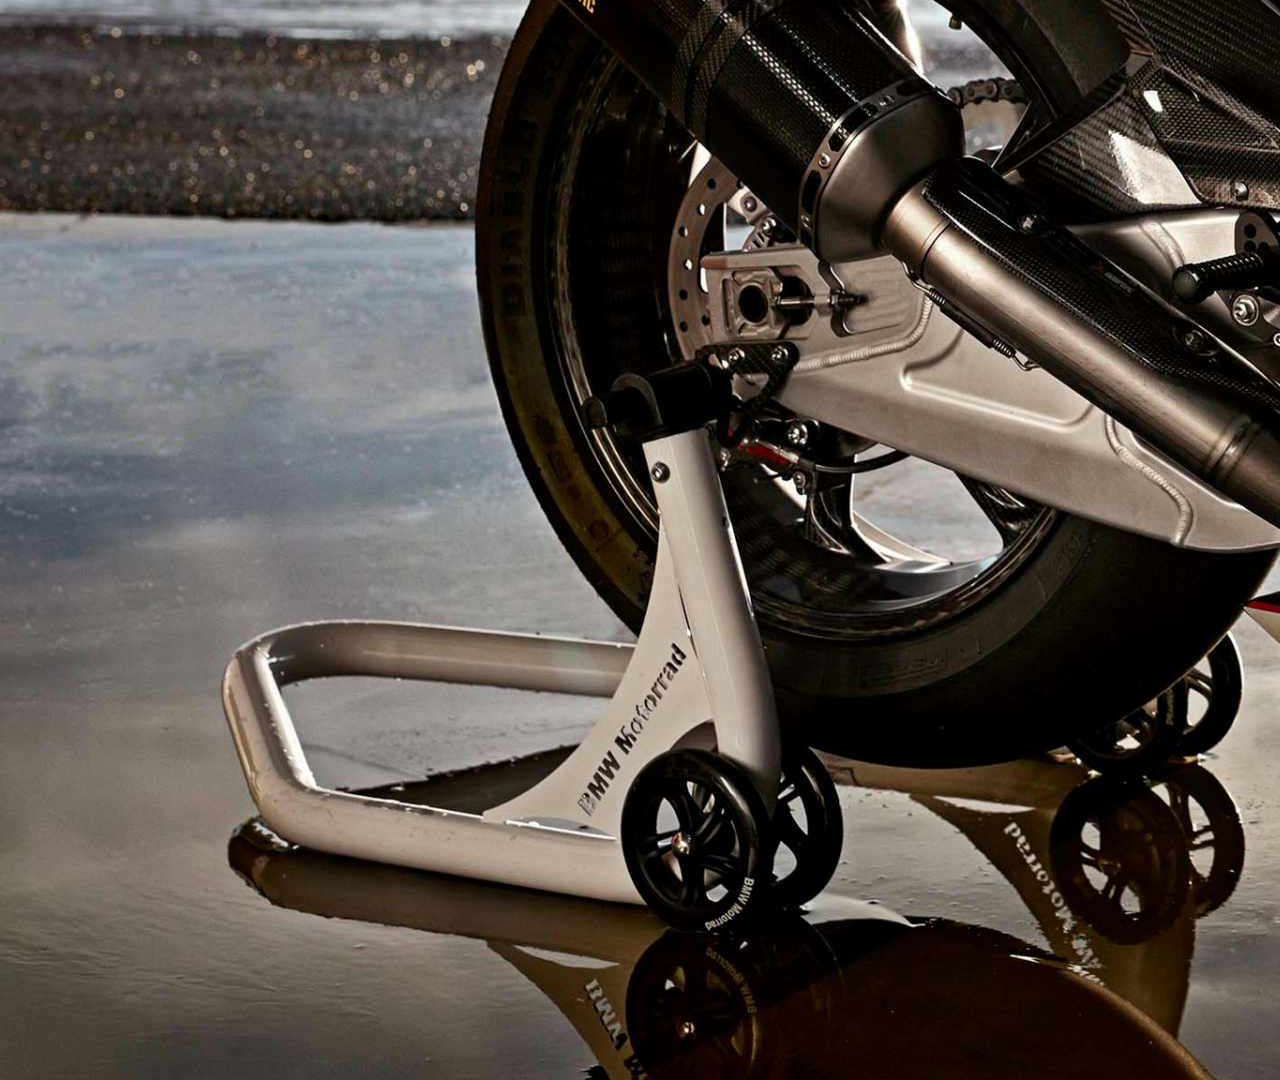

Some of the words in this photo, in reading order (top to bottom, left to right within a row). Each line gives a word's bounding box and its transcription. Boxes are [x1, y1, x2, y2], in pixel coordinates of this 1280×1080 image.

[578, 750, 621, 817] BMW
[614, 642, 687, 755] Motorrad
[738, 877, 755, 905] BMW
[704, 903, 743, 931] Motorrad
